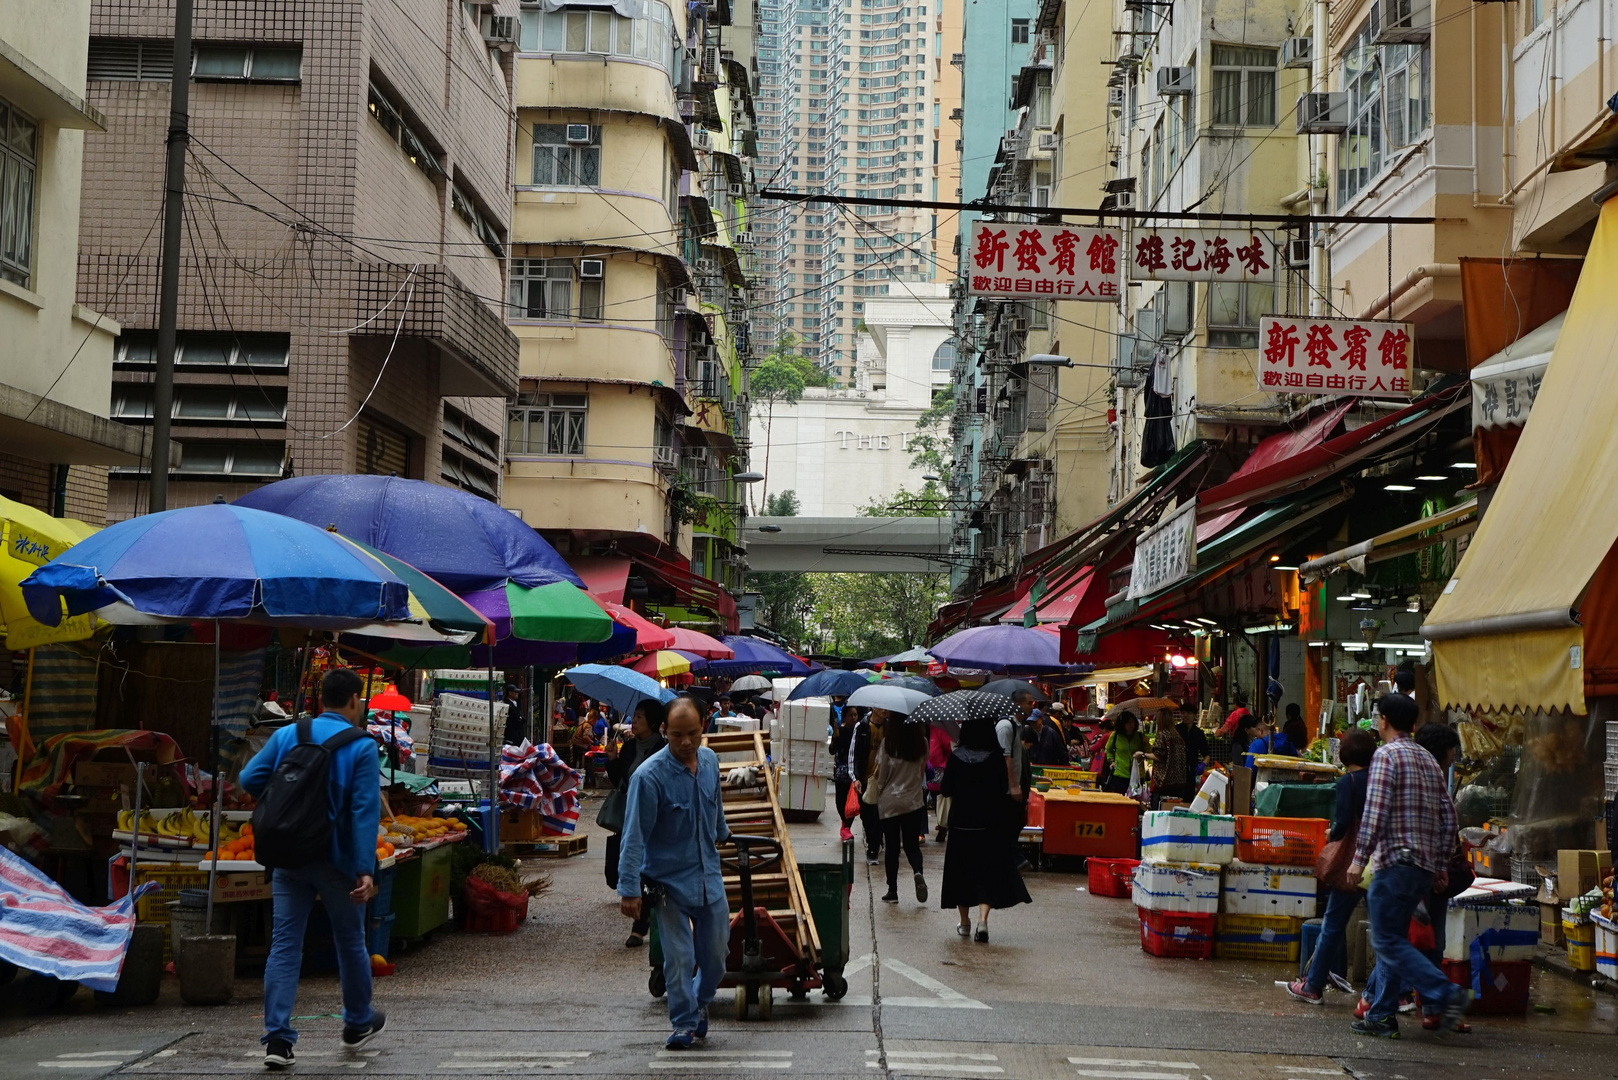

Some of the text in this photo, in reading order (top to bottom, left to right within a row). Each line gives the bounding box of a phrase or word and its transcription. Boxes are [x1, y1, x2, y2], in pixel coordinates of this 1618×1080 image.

[973, 226, 1119, 276] 新發賓館
[1135, 234, 1270, 275] 雄記海味
[972, 275, 1118, 296] 歡迎自由行人住
[1264, 321, 1411, 371] 新發賓館
[1263, 370, 1410, 392] 歡迎自由行人住
[834, 429, 891, 451] THE
[1077, 823, 1104, 837] 174
